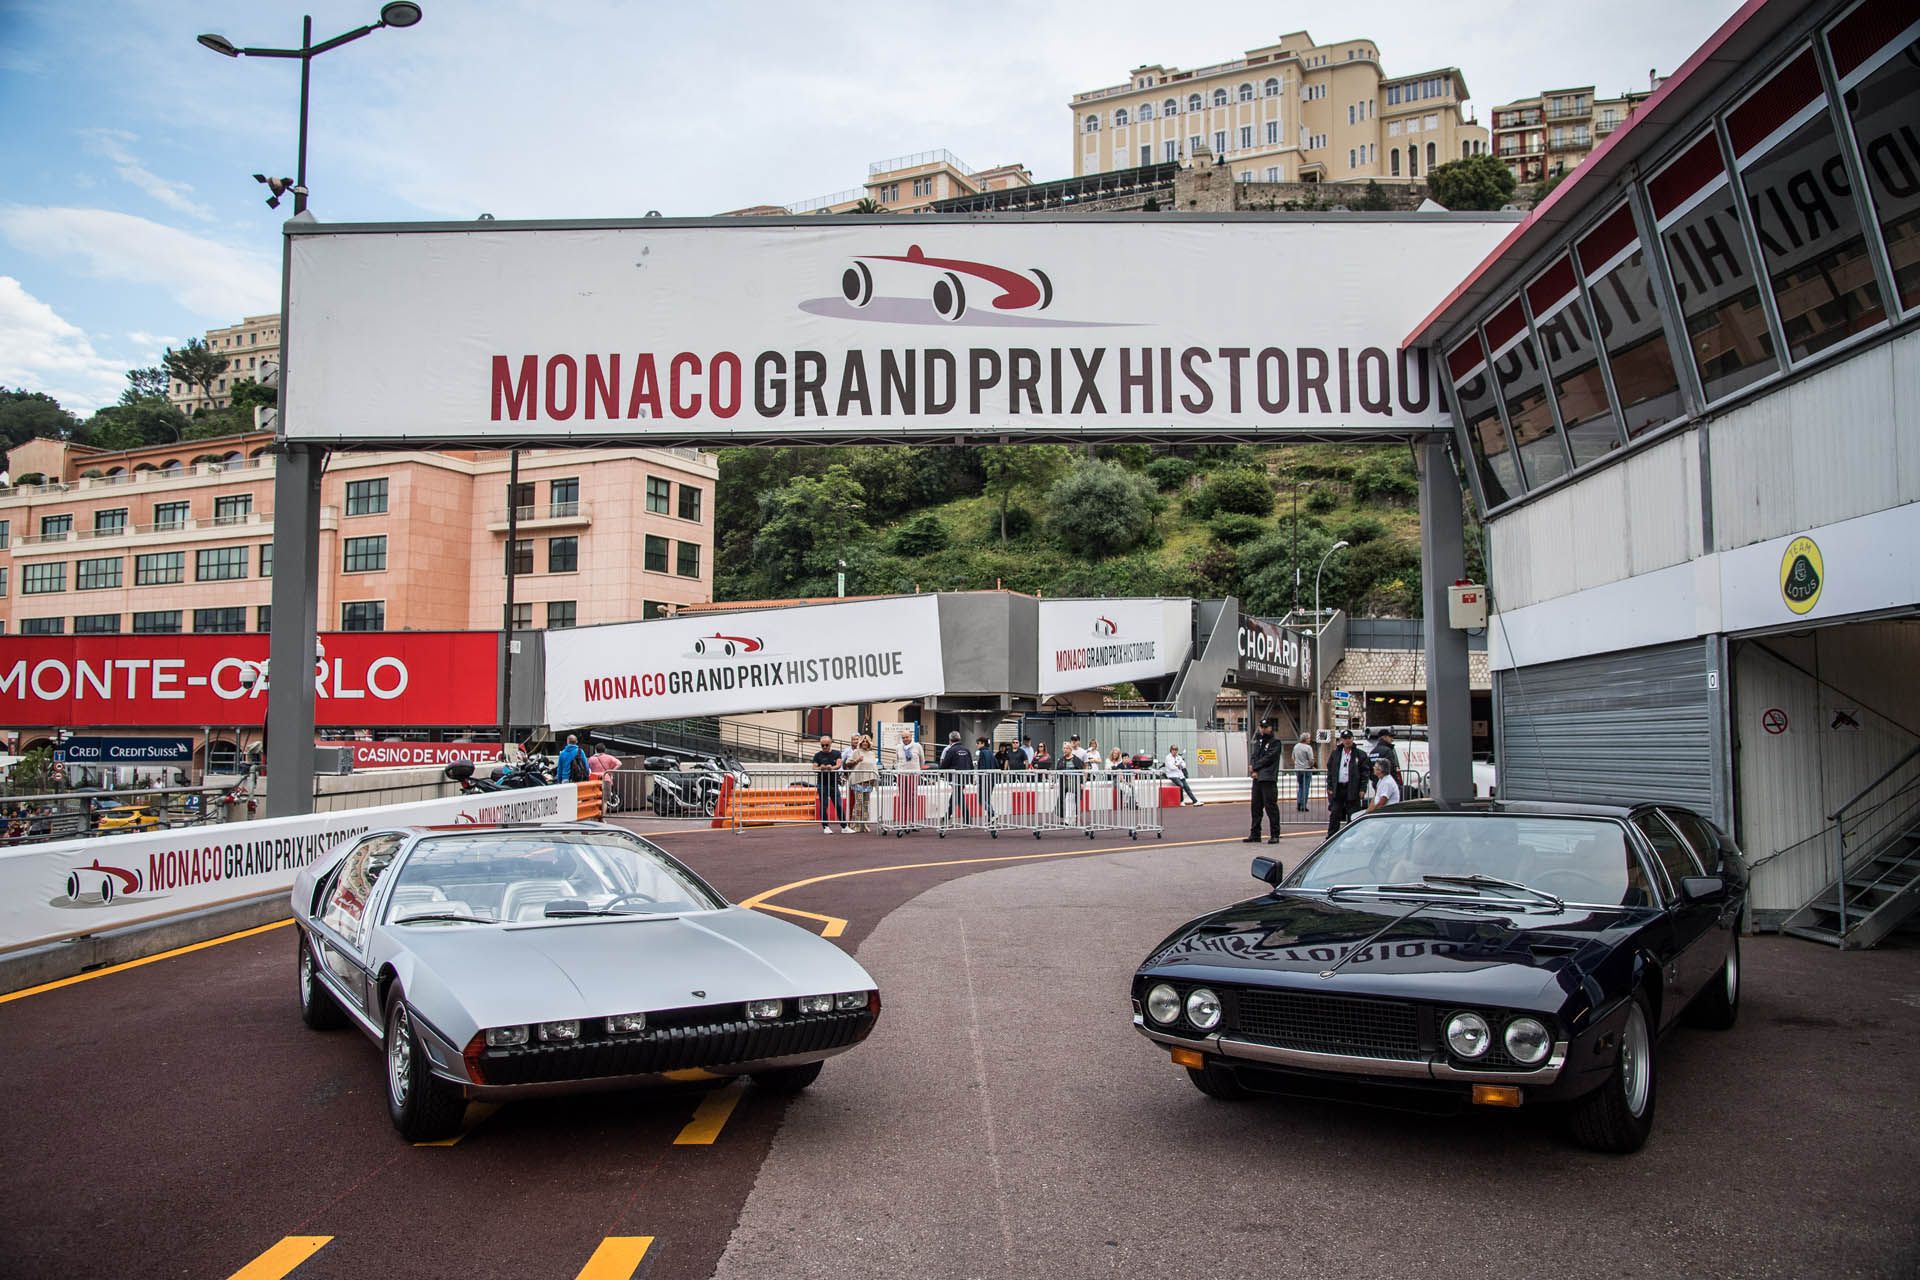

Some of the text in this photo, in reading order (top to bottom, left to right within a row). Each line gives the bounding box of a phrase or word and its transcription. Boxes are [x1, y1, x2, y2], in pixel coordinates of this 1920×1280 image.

[490, 353, 743, 422] MONACO
[754, 349, 958, 417] GRAND
[968, 347, 1107, 415] PRIX
[1789, 541, 1812, 557] TEAM
[1787, 578, 1817, 597] LOTUS
[1056, 641, 1155, 672] MONACO GRAND PRIX HISTORIQUE
[1237, 627, 1298, 667] CHOPARD
[584, 651, 904, 702] MONACO GRAND PRIX HISTORIQUE
[1247, 660, 1267, 673] OFFICIAL
[109, 745, 178, 757] CREDIT SUISSE
[357, 747, 411, 762] CASINO
[413, 750, 434, 763] DE
[149, 845, 222, 892] MONACO
[224, 840, 273, 879] GRAND
[274, 835, 304, 872] PRIX
